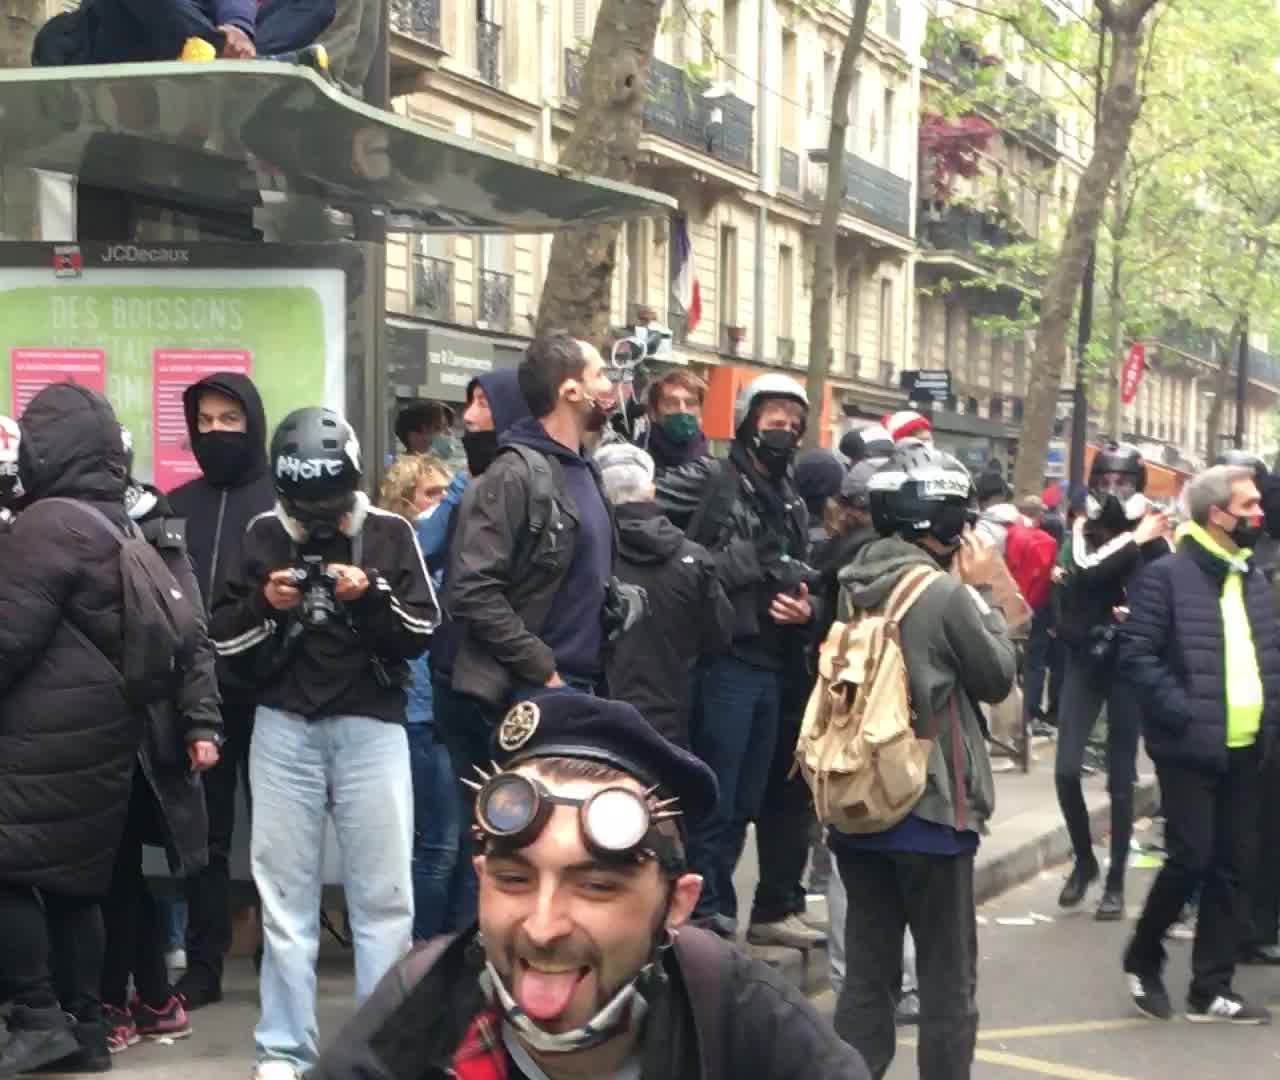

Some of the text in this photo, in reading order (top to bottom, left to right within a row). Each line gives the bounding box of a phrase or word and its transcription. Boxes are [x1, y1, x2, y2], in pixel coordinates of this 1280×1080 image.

[100, 244, 190, 262] JCDecaux
[51, 296, 243, 331] DES BOISSONS
